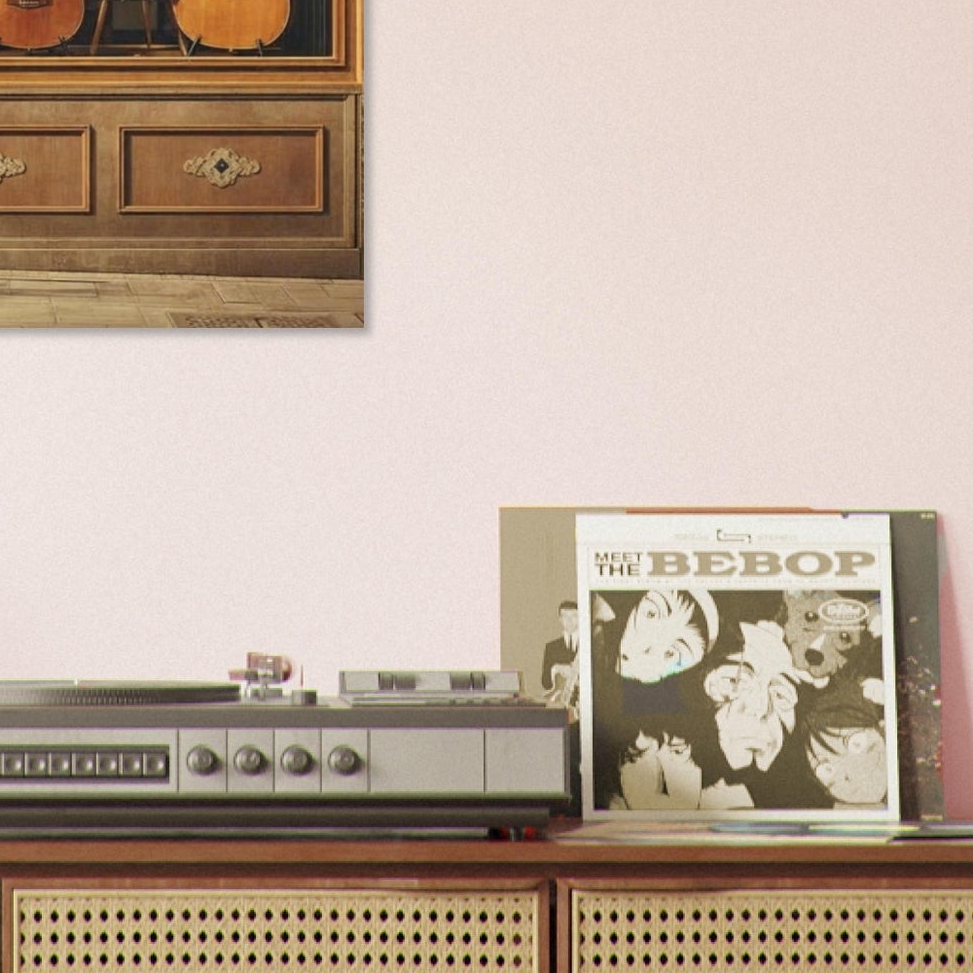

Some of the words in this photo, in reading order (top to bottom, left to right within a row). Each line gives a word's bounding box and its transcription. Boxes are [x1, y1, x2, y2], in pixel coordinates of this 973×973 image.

[594, 552, 644, 563] MEET
[646, 551, 876, 577] BEBOP
[594, 563, 642, 576] THE
